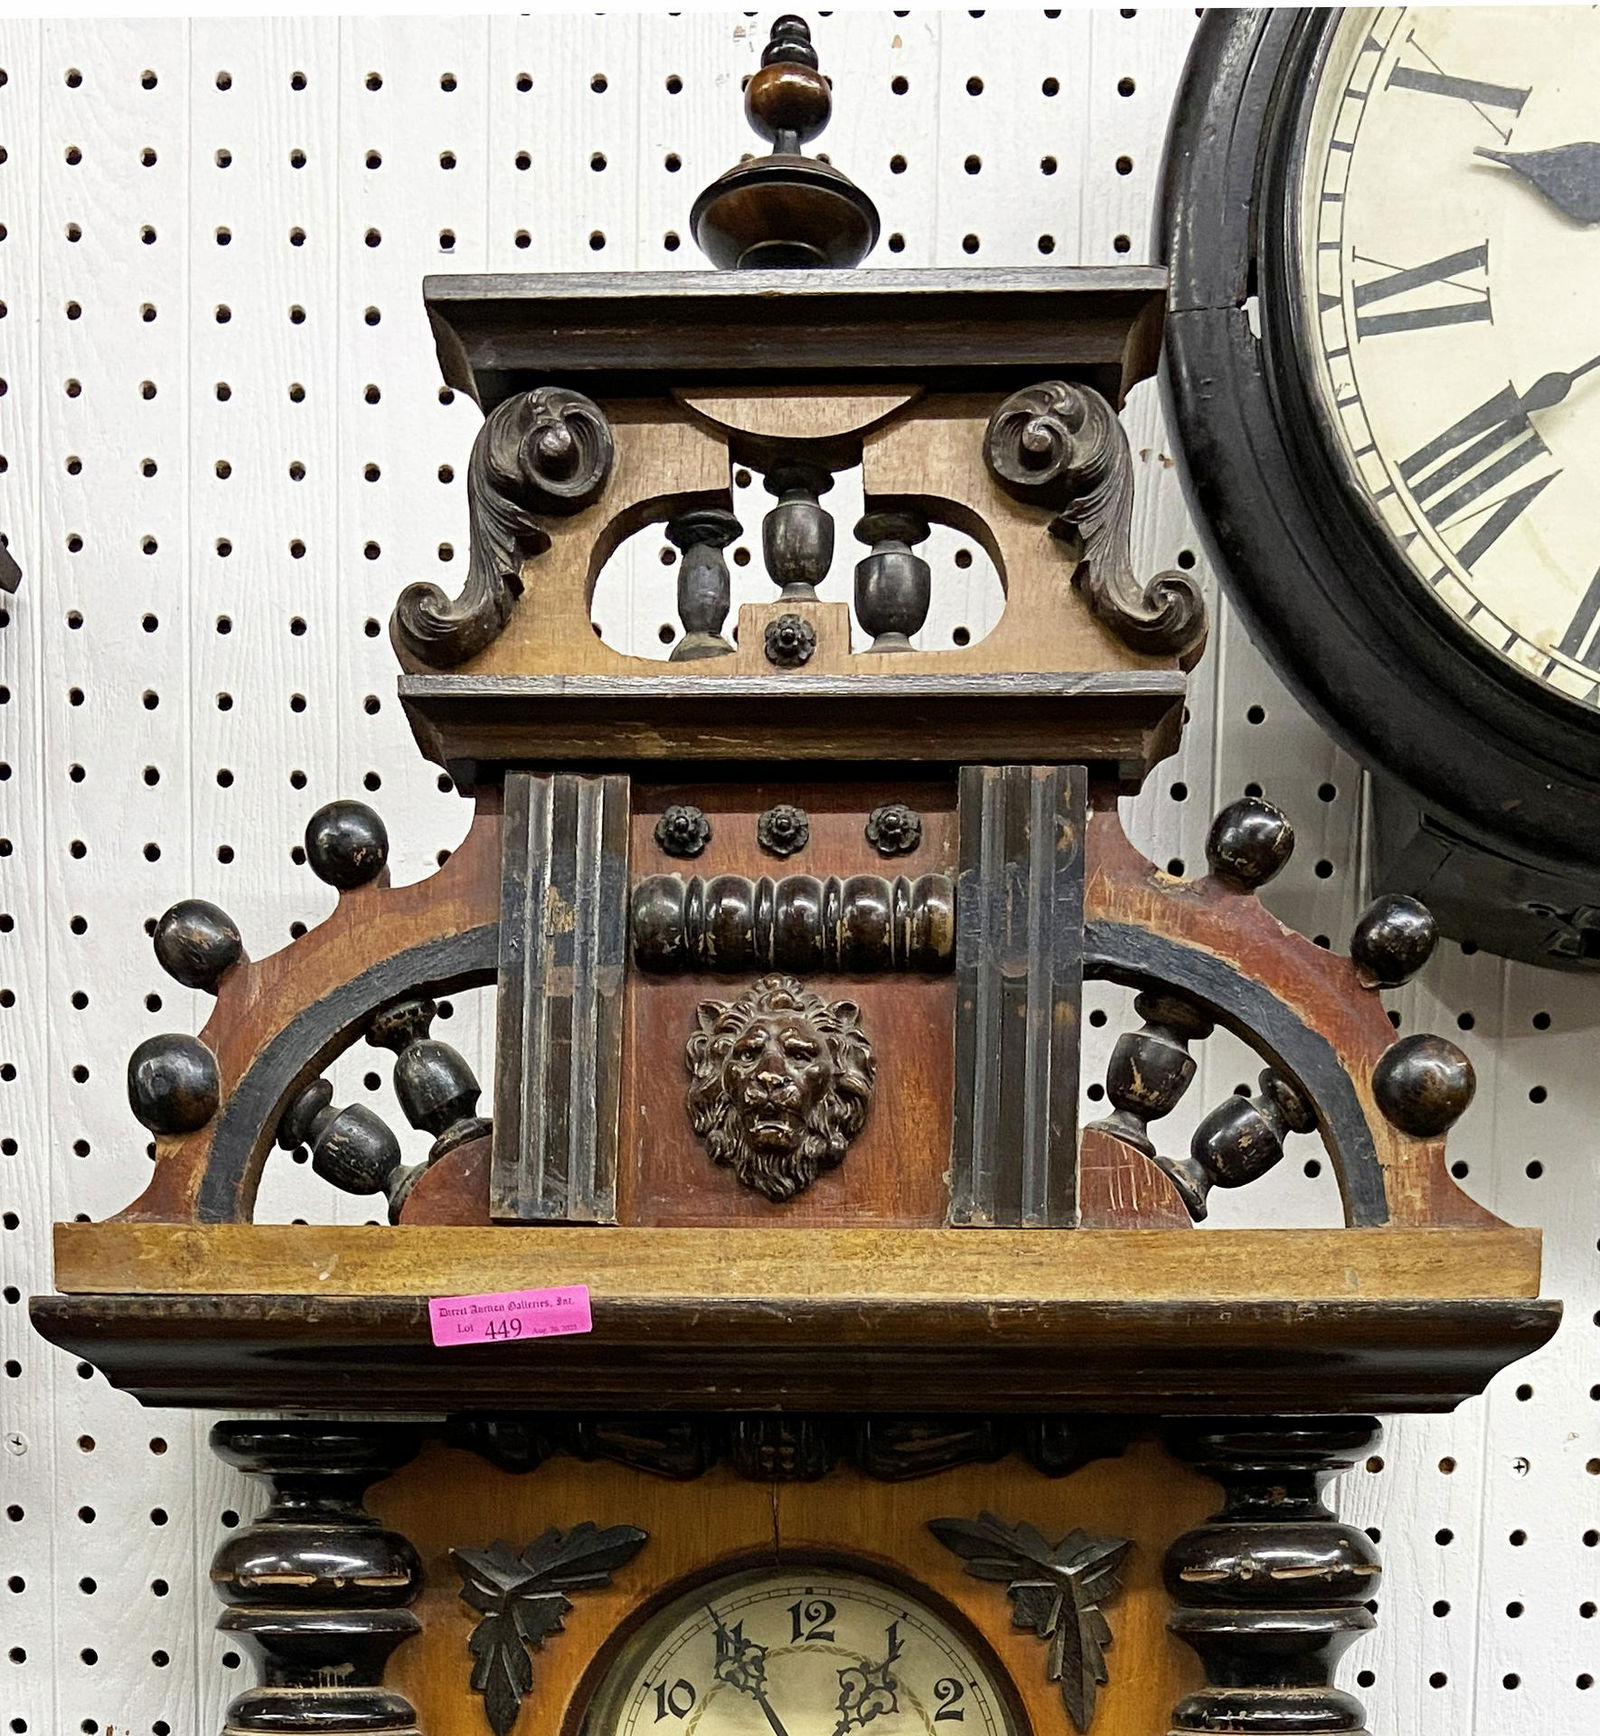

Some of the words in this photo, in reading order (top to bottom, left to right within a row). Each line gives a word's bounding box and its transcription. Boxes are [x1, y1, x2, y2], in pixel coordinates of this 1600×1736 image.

[457, 1323, 474, 1333] Lot
[485, 1318, 522, 1339] 449
[787, 1600, 836, 1643] 12
[885, 1620, 902, 1657] 1
[653, 1678, 696, 1723] 10
[933, 1677, 965, 1722] 2
